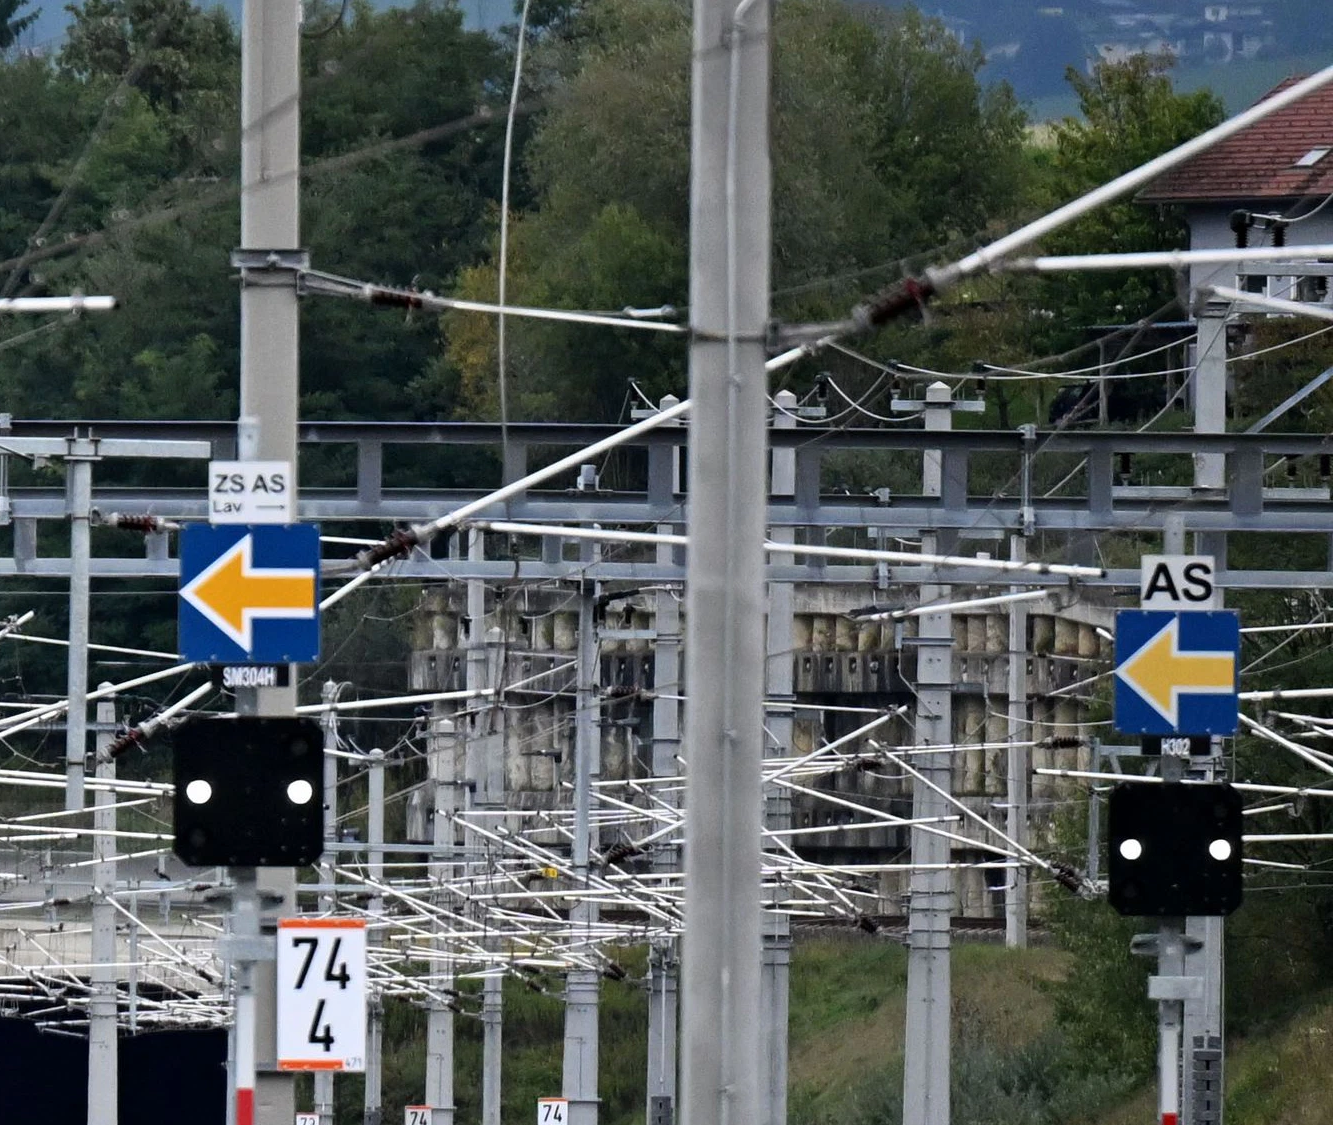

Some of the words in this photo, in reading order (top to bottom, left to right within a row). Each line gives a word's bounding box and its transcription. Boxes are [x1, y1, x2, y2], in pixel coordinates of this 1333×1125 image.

[213, 473, 245, 494] ZS
[251, 473, 285, 494] AS
[213, 500, 242, 513] Lav
[1143, 562, 1212, 602] AS
[222, 666, 277, 687] SM304H
[292, 937, 350, 989] 74
[308, 998, 334, 1051] 4
[543, 1104, 562, 1122] 74
